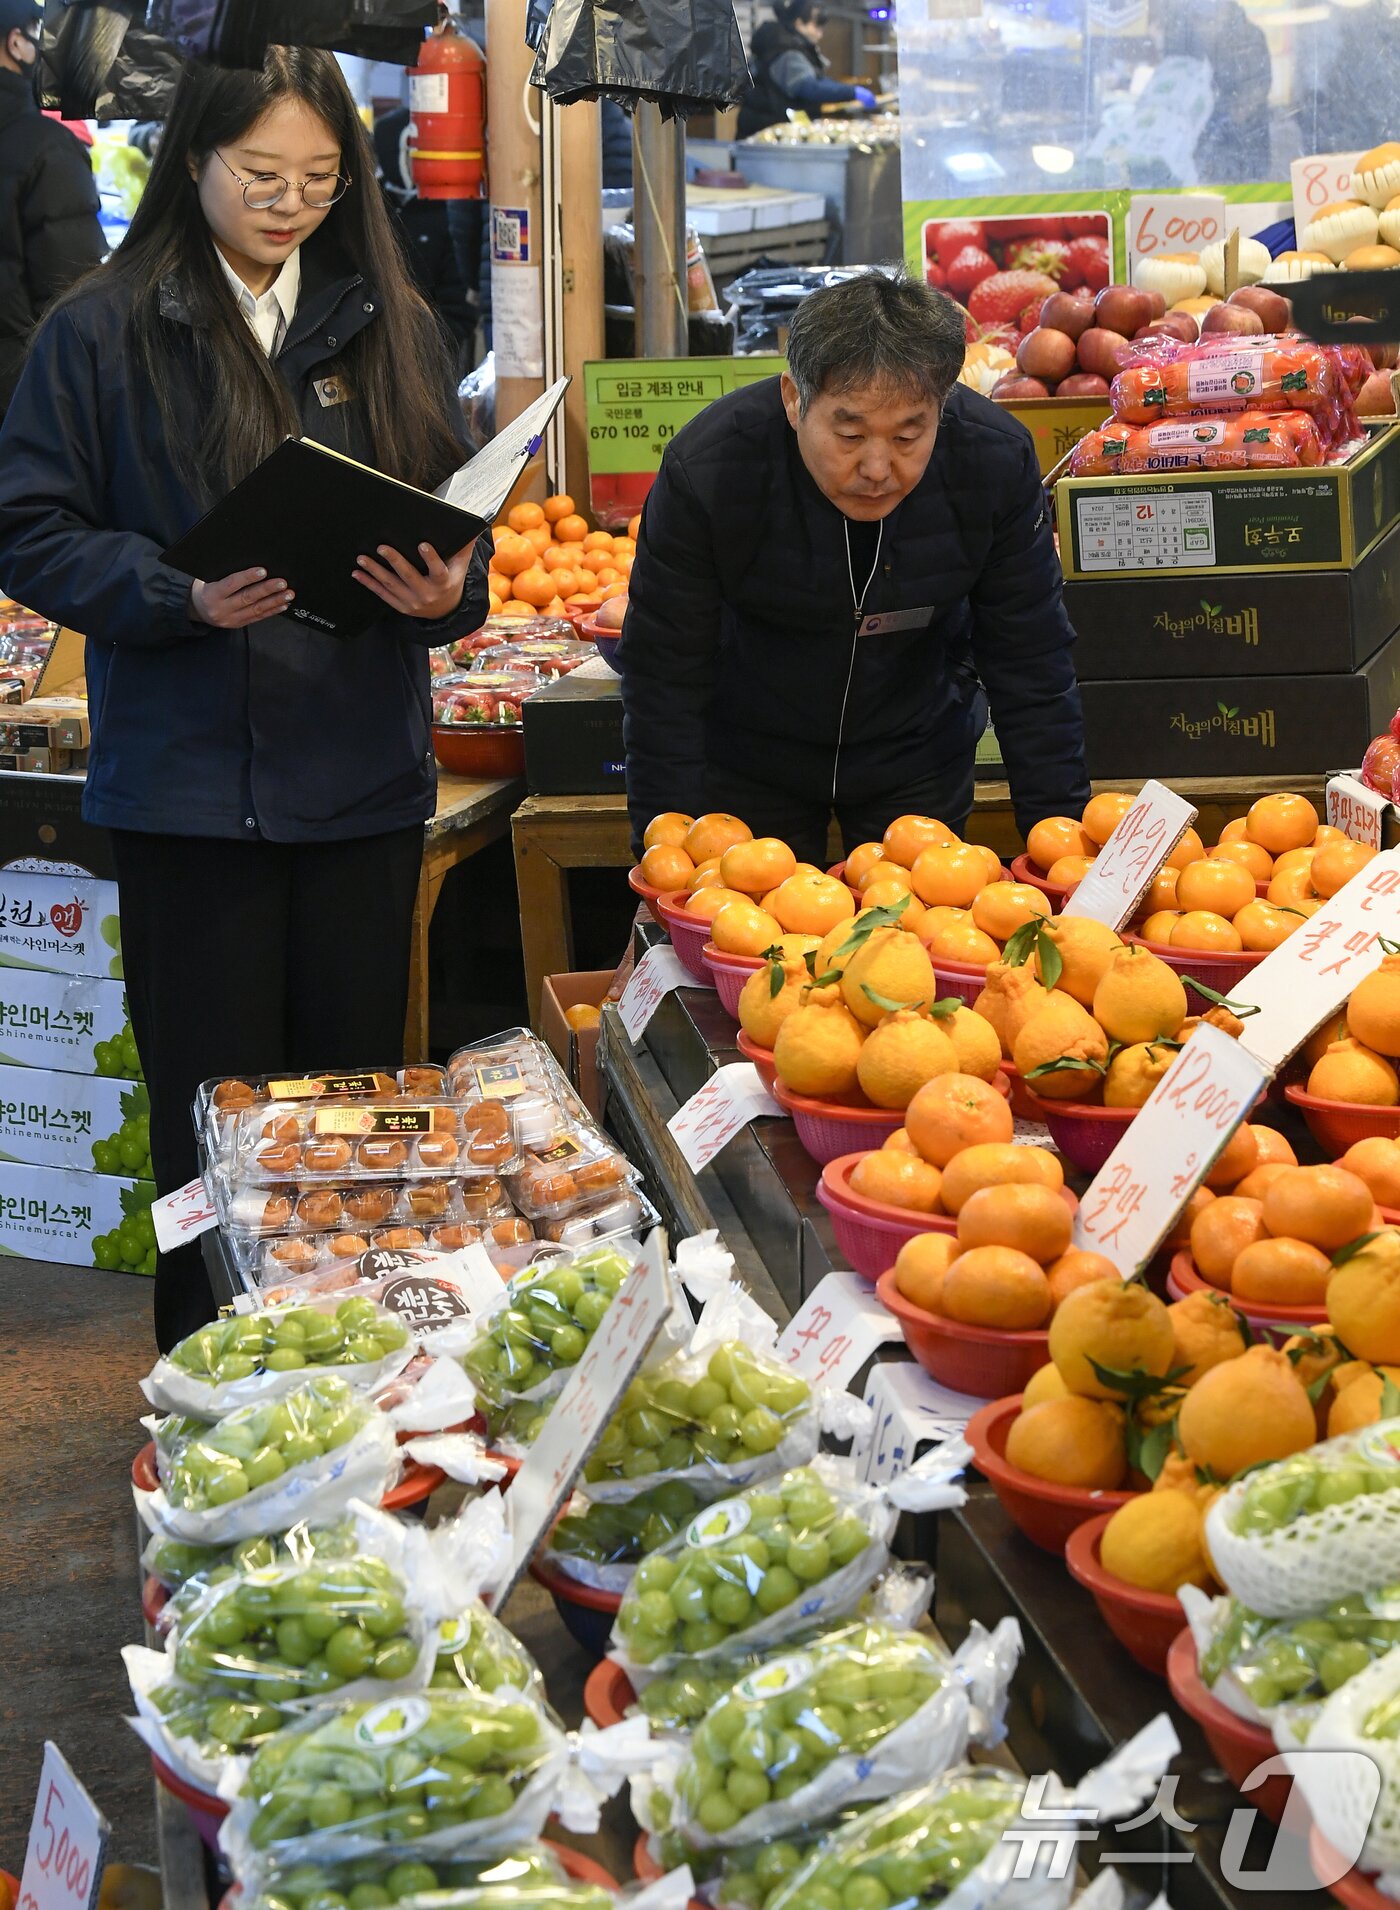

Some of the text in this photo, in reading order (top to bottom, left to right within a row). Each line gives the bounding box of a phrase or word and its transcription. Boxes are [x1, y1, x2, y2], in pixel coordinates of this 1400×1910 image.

[617, 381, 703, 397] 입금 계좌 안내
[604, 408, 643, 420] 국민은행
[590, 426, 617, 439] 670
[623, 425, 649, 438] 102
[1136, 505, 1154, 519] 12
[22, 937, 85, 956] 샤인머스켓
